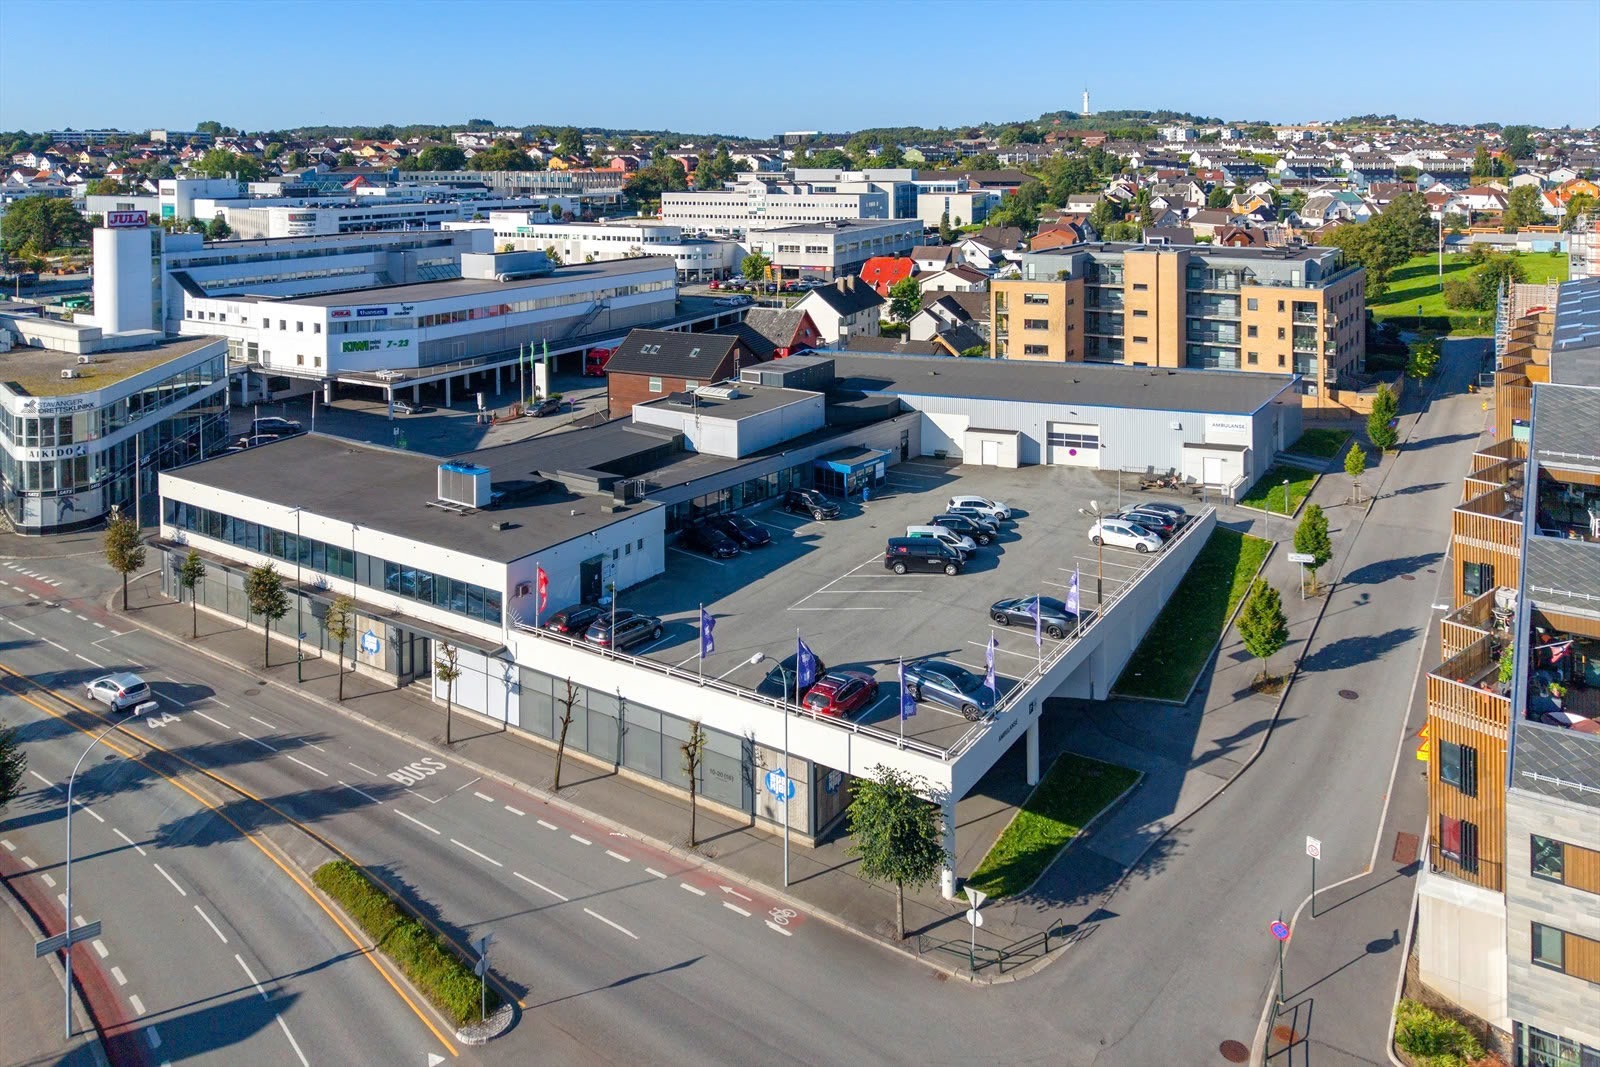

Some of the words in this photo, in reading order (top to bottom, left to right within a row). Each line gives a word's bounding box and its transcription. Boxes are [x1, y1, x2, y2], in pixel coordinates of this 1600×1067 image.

[110, 214, 145, 224] JULA
[342, 340, 369, 353] KIWI
[38, 398, 83, 408] STAVANGER
[29, 447, 73, 458] AIKIDO
[146, 712, 182, 729] 44
[386, 757, 447, 787] BUSS
